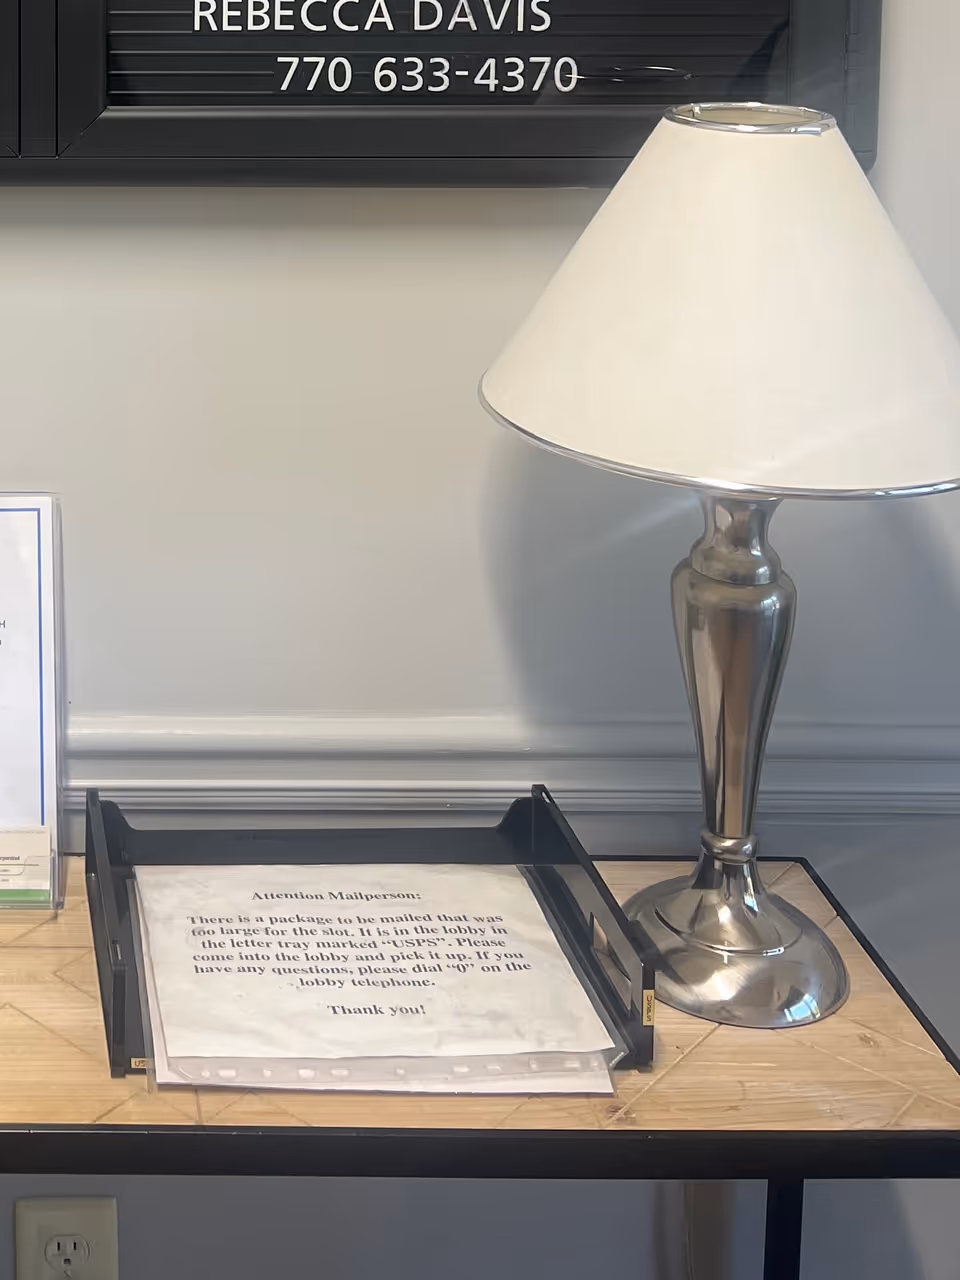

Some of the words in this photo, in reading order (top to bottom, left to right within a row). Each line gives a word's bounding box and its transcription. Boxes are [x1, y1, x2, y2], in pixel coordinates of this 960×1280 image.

[277, 57, 351, 91] 770
[375, 57, 581, 91] 633-4370
[252, 891, 325, 901] Attention
[328, 891, 422, 902] Mailperson:
[187, 915, 234, 925] There
[238, 915, 250, 923] is
[268, 914, 333, 925] package
[337, 916, 353, 925] to
[355, 915, 375, 924] be
[380, 913, 433, 924] mailed
[437, 914, 468, 922] that
[472, 915, 503, 923] was
[191, 928, 216, 937] too
[220, 927, 260, 937] large
[264, 927, 288, 936] for
[292, 927, 318, 936] the
[322, 927, 355, 937] slot.
[359, 928, 372, 937] It
[376, 927, 390, 936] is
[393, 927, 410, 936] in
[413, 925, 439, 935] the
[442, 925, 486, 936] lobby
[490, 925, 508, 935] in
[201, 940, 226, 949] the
[230, 939, 273, 949] letter
[277, 940, 310, 950] tray
[316, 940, 378, 949] marked
[456, 937, 506, 948] Please
[192, 954, 234, 962] come
[239, 952, 271, 961] into
[275, 952, 300, 962] the
[305, 952, 350, 963] lobby
[355, 953, 385, 961] and
[390, 951, 424, 963] pick
[428, 951, 441, 960] it
[445, 953, 472, 962] up.
[475, 951, 490, 960] If
[494, 952, 524, 961] you
[193, 965, 233, 974] have
[237, 965, 266, 975] any
[271, 966, 354, 976] questions,
[357, 965, 407, 976] please
[412, 963, 443, 973] dial
[480, 964, 502, 973] on
[505, 962, 532, 971] the
[299, 977, 345, 989] lobby
[351, 978, 436, 989] telephone.
[327, 1005, 385, 1015] Thank
[389, 1004, 426, 1016] you!
